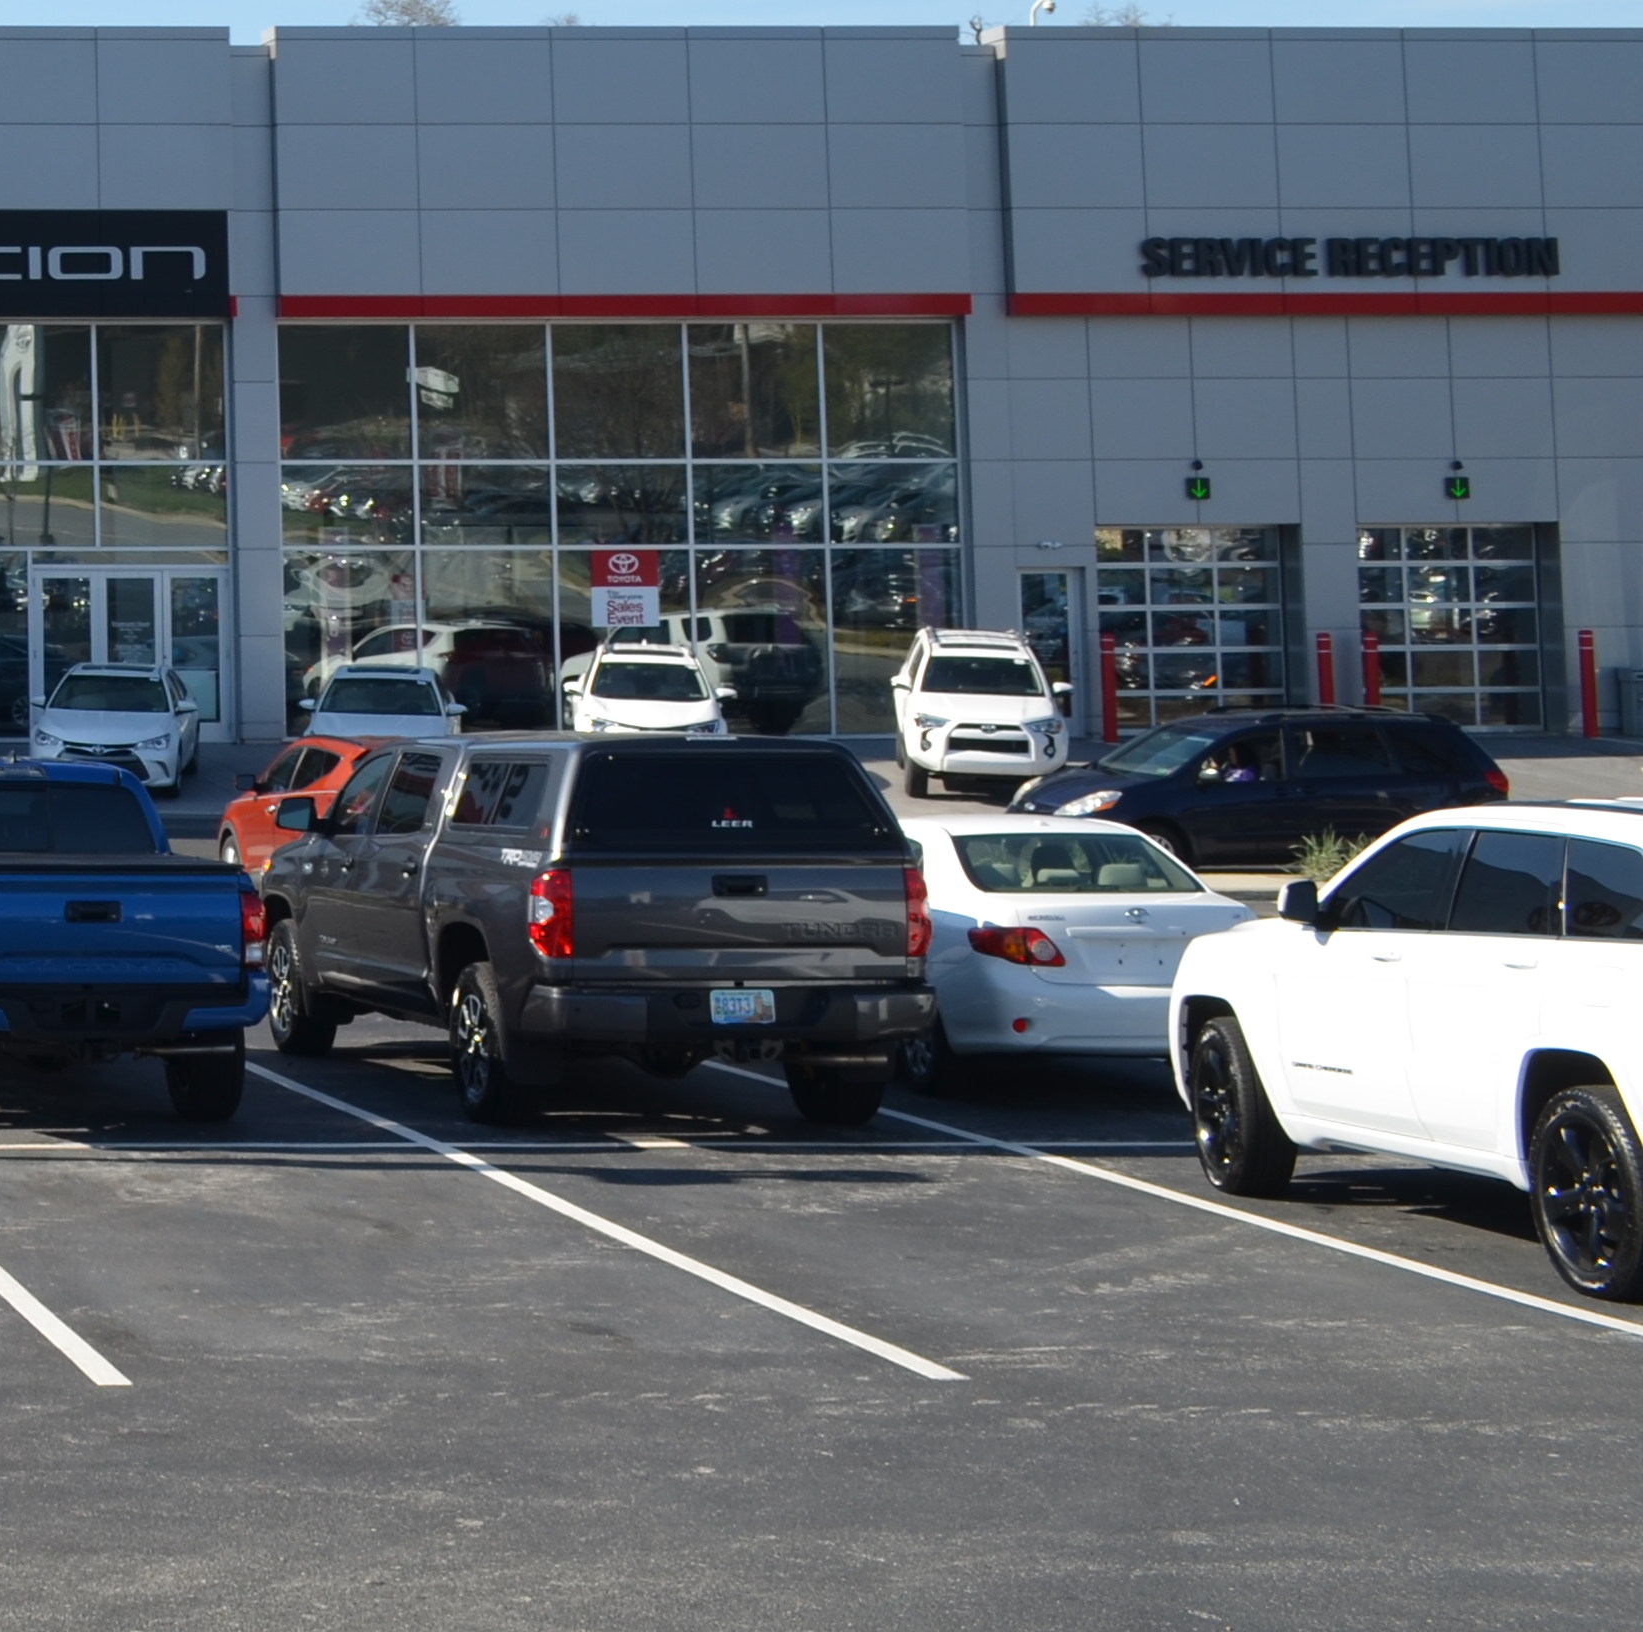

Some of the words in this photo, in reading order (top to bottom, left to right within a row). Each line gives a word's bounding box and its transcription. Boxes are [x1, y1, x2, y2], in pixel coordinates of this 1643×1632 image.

[1139, 236, 1318, 278] SERVICE
[1326, 236, 1561, 278] RECEPTION
[606, 575, 642, 583] TOYOTA
[607, 600, 644, 613] Sales
[607, 612, 644, 625] Event
[711, 819, 754, 828] LEER
[781, 922, 899, 939] TUNDRA
